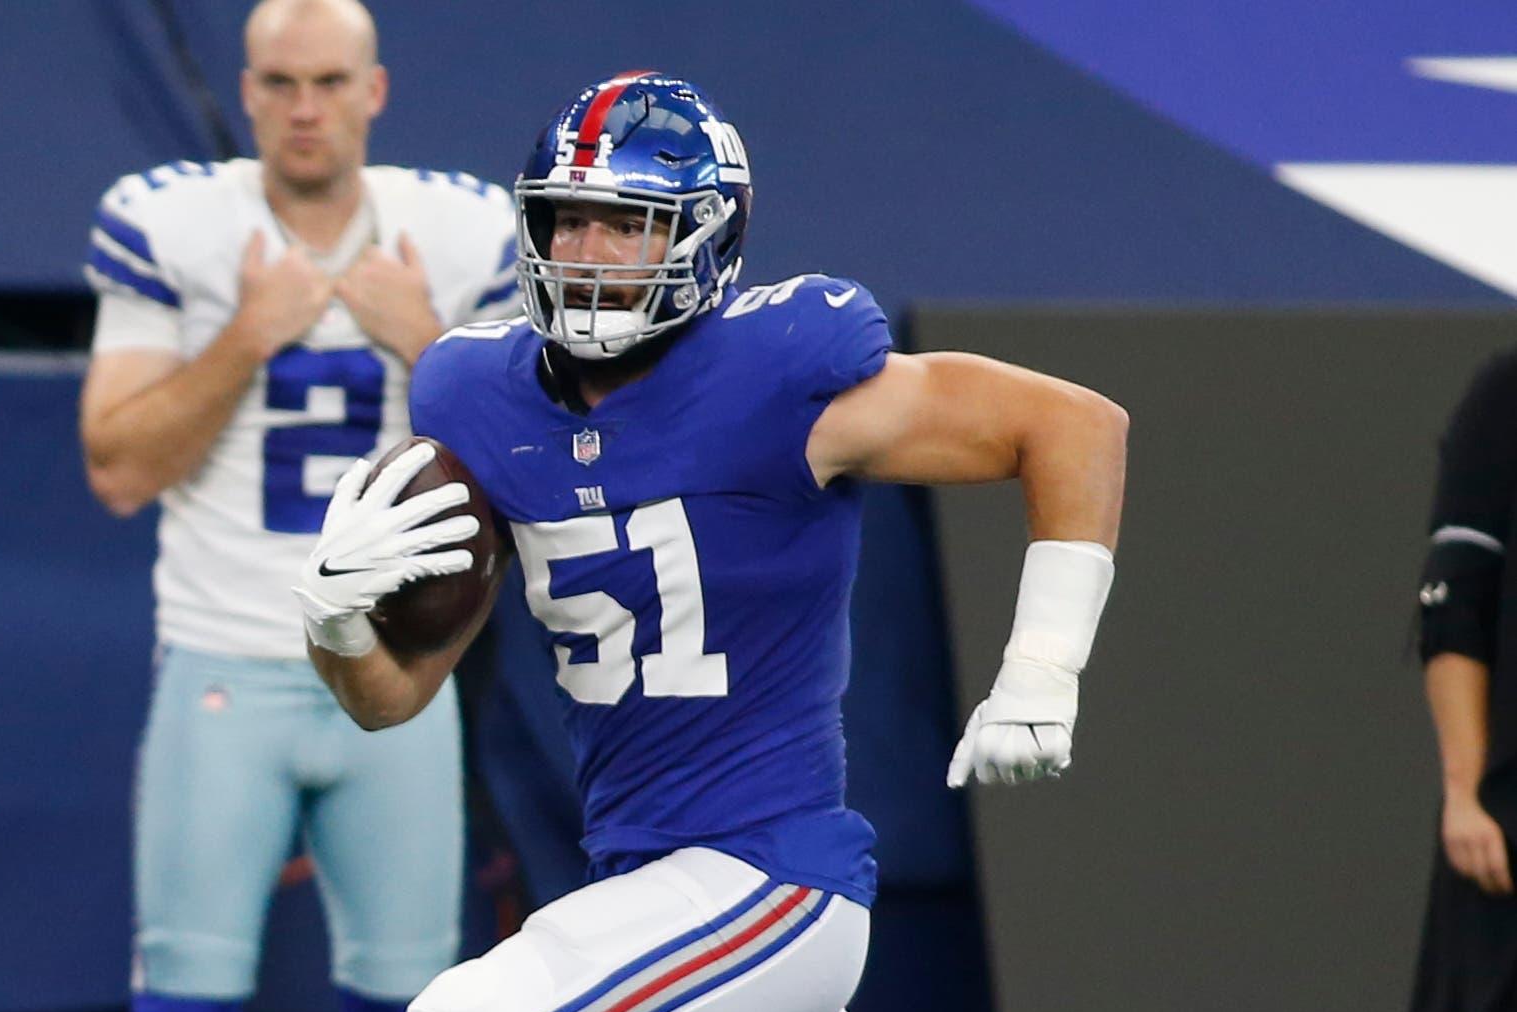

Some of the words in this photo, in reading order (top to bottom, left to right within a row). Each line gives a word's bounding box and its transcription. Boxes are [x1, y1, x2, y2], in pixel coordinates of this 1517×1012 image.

[555, 131, 614, 168] 51
[262, 344, 388, 535] 2
[508, 497, 729, 706] 51
